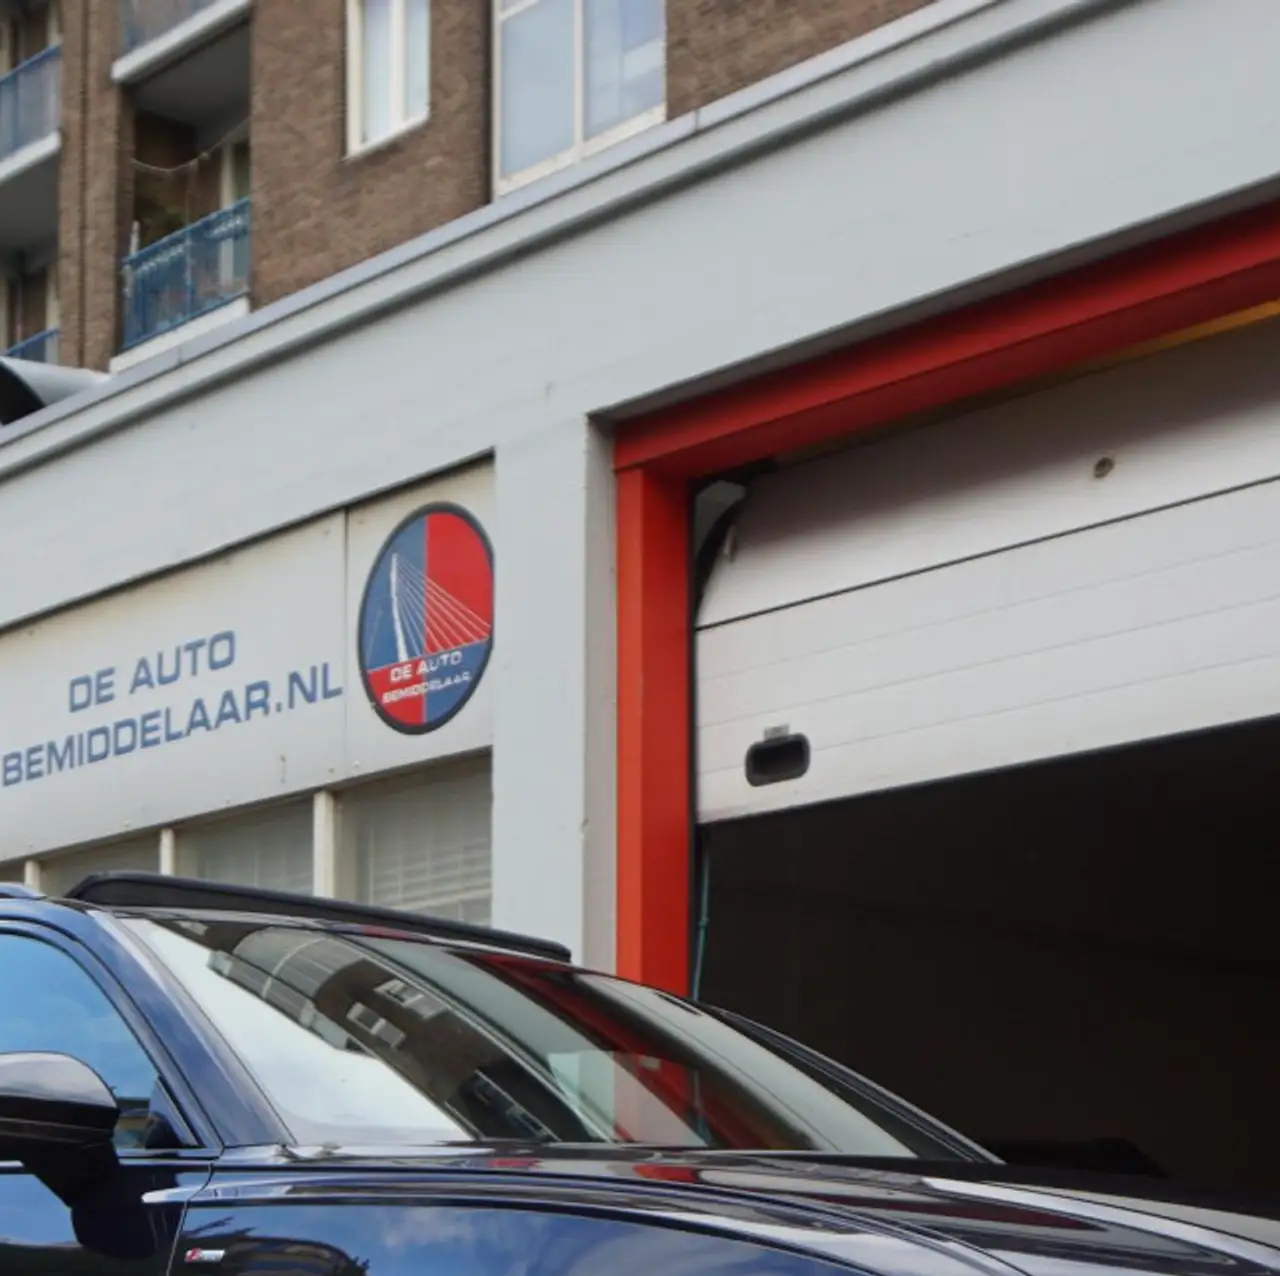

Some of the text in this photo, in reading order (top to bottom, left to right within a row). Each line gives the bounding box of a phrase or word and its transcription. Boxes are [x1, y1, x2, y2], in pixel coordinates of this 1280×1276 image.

[69, 630, 237, 713] DE AUTO
[390, 651, 463, 682] DE AUTO
[2, 662, 344, 787] BEMIDDELAAR.NL
